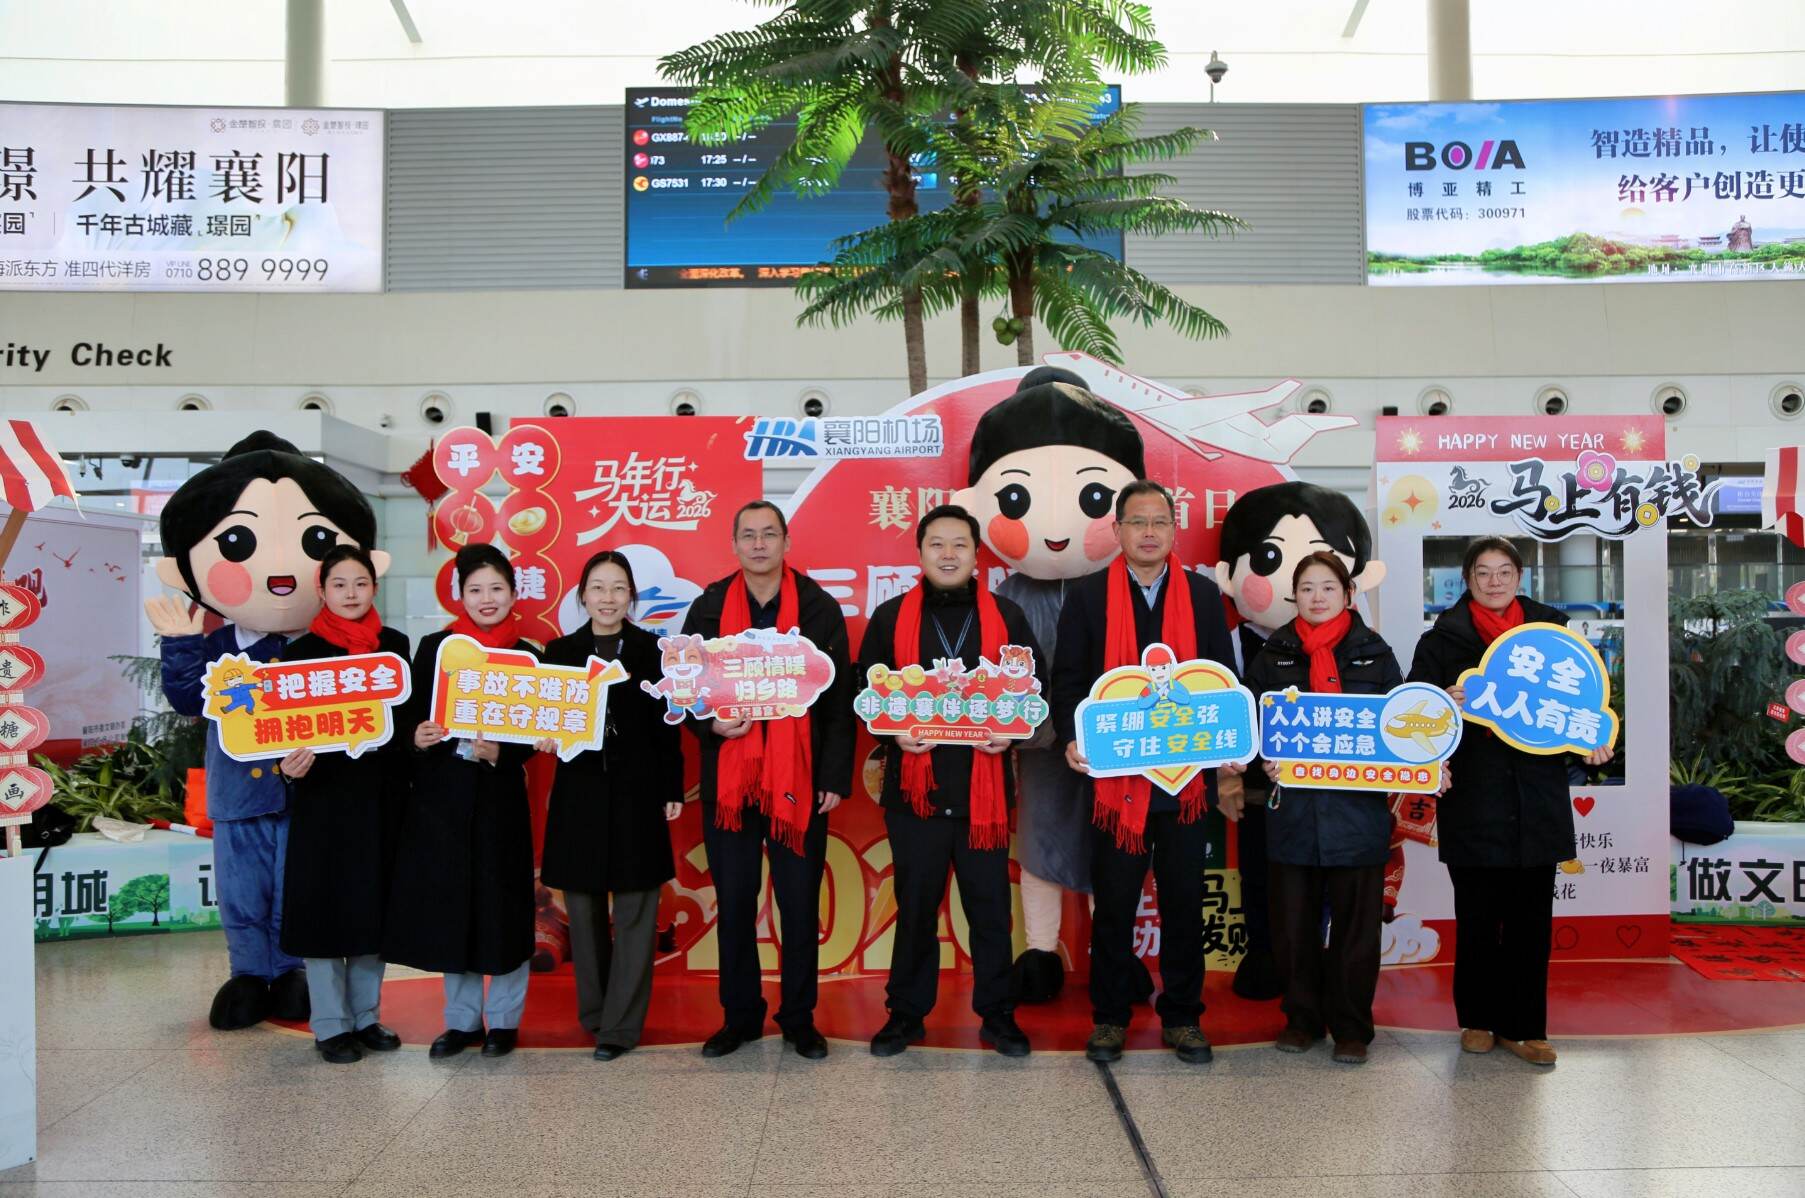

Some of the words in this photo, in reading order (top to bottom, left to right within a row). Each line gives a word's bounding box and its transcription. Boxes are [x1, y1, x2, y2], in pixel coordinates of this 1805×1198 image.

[701, 154, 727, 165] 17:25
[651, 178, 689, 189] GS7531
[701, 177, 728, 188] 17:30
[1407, 180, 1527, 198] 博亚精工
[1478, 207, 1526, 219] 300971
[64, 259, 151, 278] 准四代洋房
[198, 258, 249, 281] 889
[261, 258, 329, 281] 9999
[0, 343, 51, 372] ity
[71, 343, 173, 367] Check
[823, 418, 941, 446] 襄阳机场
[1438, 433, 1498, 449] HAPPY
[1511, 433, 1547, 449] NEW
[1557, 433, 1604, 449] YEAR
[448, 442, 544, 476] 平安
[825, 447, 891, 456] XIANGYANG
[894, 445, 940, 454] AIRPORT
[573, 451, 686, 502] 马年行
[676, 503, 712, 519] 2026
[1449, 488, 1487, 510] 2026
[1491, 460, 1716, 538] 马上有钱
[722, 655, 806, 678] 三顾情暖
[1506, 644, 1586, 696] 安全
[277, 664, 398, 700] 把握安全
[456, 668, 591, 704] 事故不难防
[734, 678, 798, 701] 归乡路
[453, 699, 588, 734] 重在守规章
[1095, 704, 1220, 735] 紧绷安全弦
[1270, 706, 1376, 730] 人人讲安全
[1470, 681, 1602, 745] 人人有责
[254, 707, 376, 744] 拥抱明天
[918, 729, 943, 737] HAPPY
[964, 730, 984, 738] YEAR
[1113, 728, 1238, 759] 守住安全线
[1269, 731, 1376, 756] 个个会应急
[1584, 855, 1650, 874] 一夜暴富
